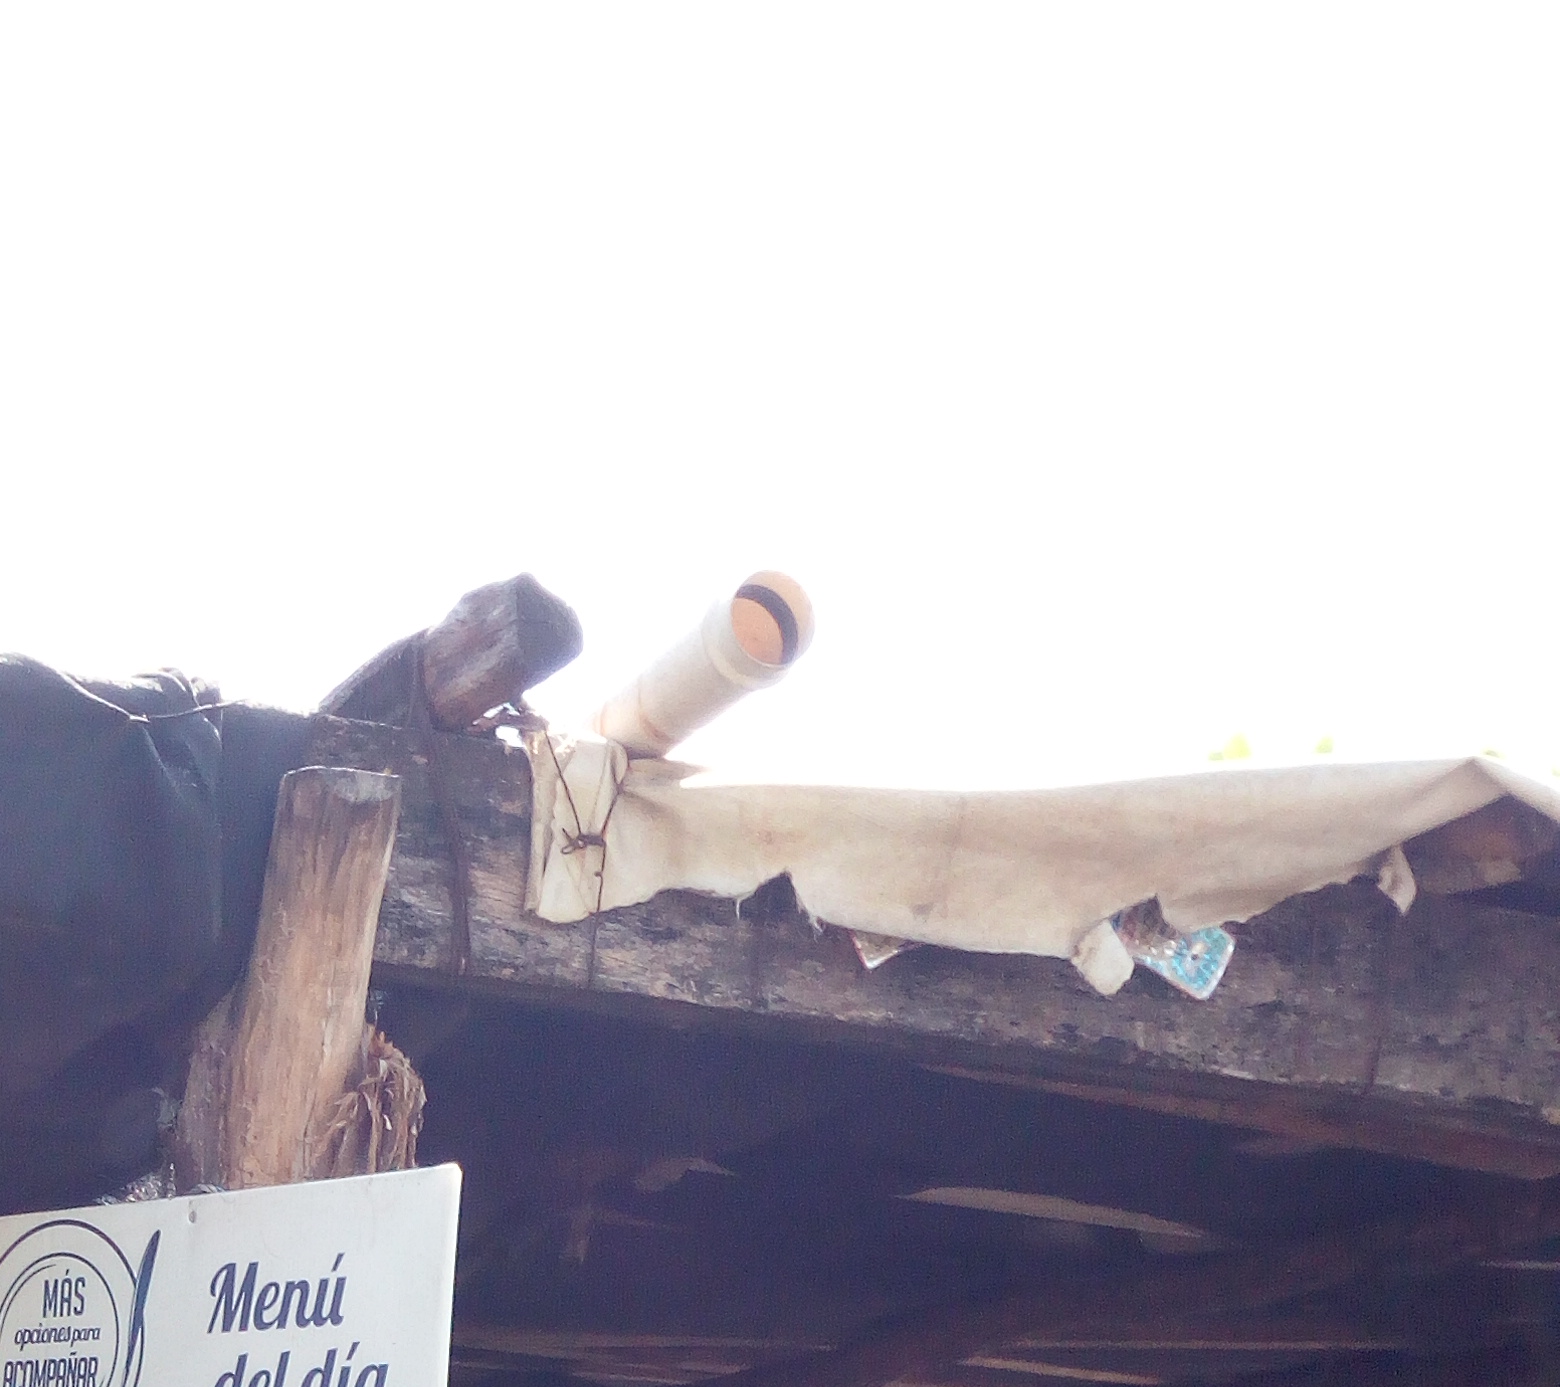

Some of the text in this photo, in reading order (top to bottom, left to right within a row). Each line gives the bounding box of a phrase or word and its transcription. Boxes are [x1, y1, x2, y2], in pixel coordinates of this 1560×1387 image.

[42, 1268, 86, 1318] MÁS
[207, 1252, 347, 1334] Menú
[14, 1322, 101, 1351] opciones para
